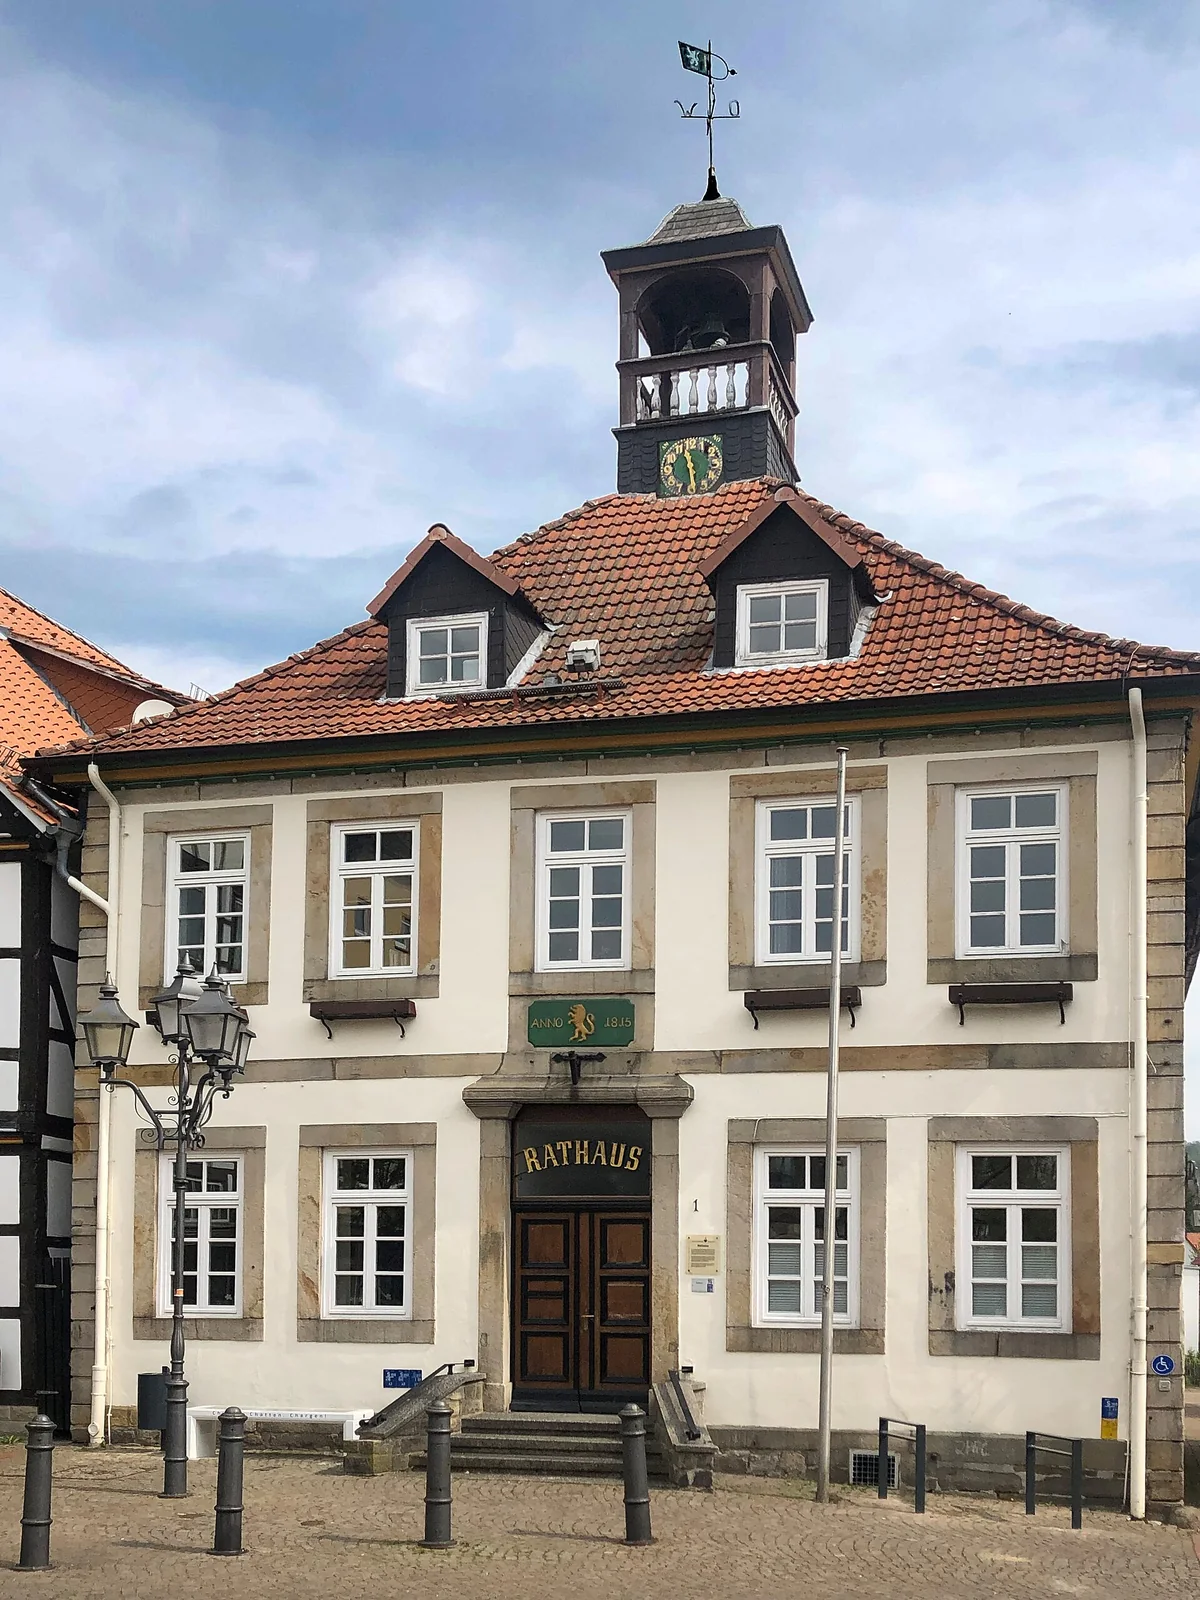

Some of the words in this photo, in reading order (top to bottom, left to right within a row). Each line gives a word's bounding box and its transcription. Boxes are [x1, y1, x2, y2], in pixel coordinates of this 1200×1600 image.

[729, 100, 740, 116] O
[675, 443, 684, 454] 11
[684, 439, 697, 450] 12
[699, 441, 704, 451] 1
[708, 446, 715, 457] 2
[666, 453, 676, 464] 10
[711, 458, 720, 469] 3
[663, 465, 673, 476] 9
[708, 470, 716, 480] 4
[667, 476, 675, 486] 8
[700, 480, 708, 490] 5
[676, 483, 683, 493] 7
[530, 1017, 563, 1029] ANNO
[604, 1016, 632, 1029] 1815
[523, 1140, 643, 1173] RATHAUS
[693, 1199, 699, 1212] 1
